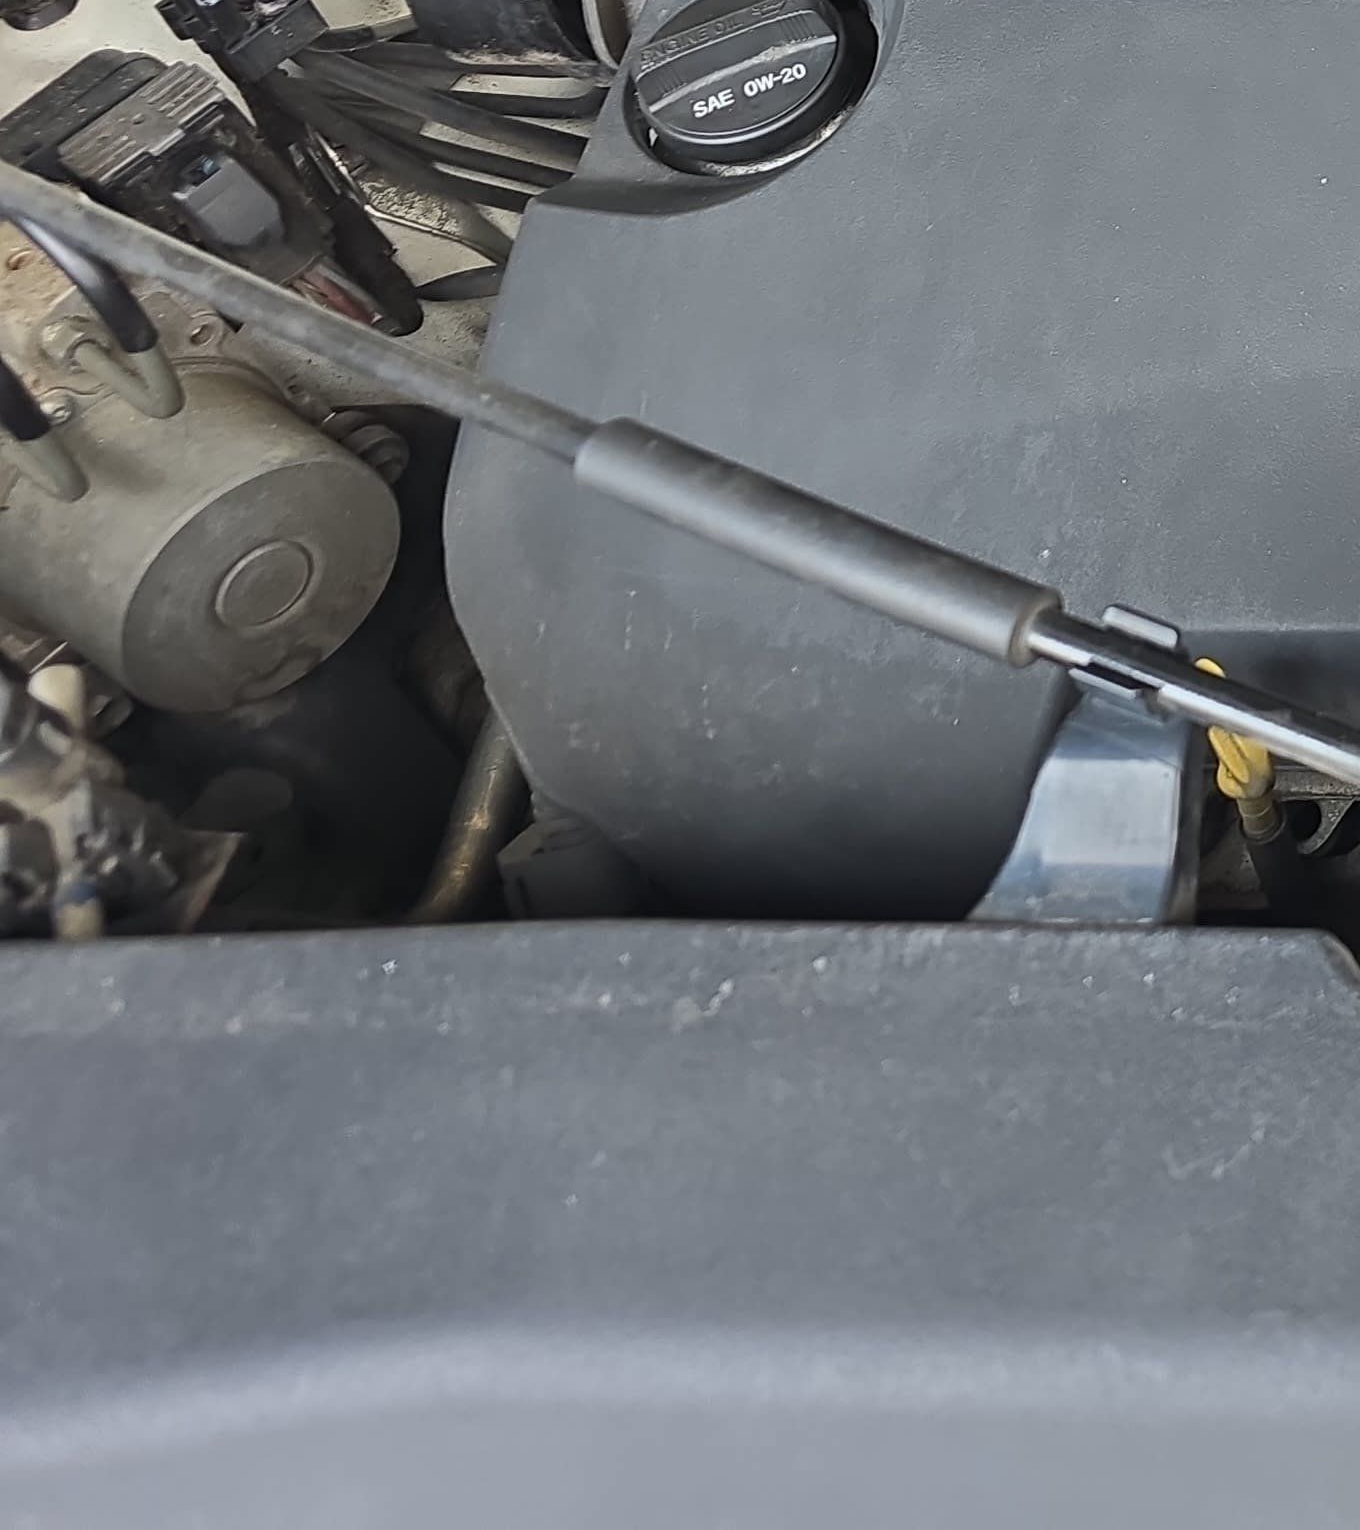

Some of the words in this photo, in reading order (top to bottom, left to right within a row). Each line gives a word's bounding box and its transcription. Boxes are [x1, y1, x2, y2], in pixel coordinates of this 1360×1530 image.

[641, 27, 712, 63] ENGINE
[713, 18, 744, 36] OIL
[692, 88, 736, 118] SAE
[743, 63, 807, 98] 0W-20
